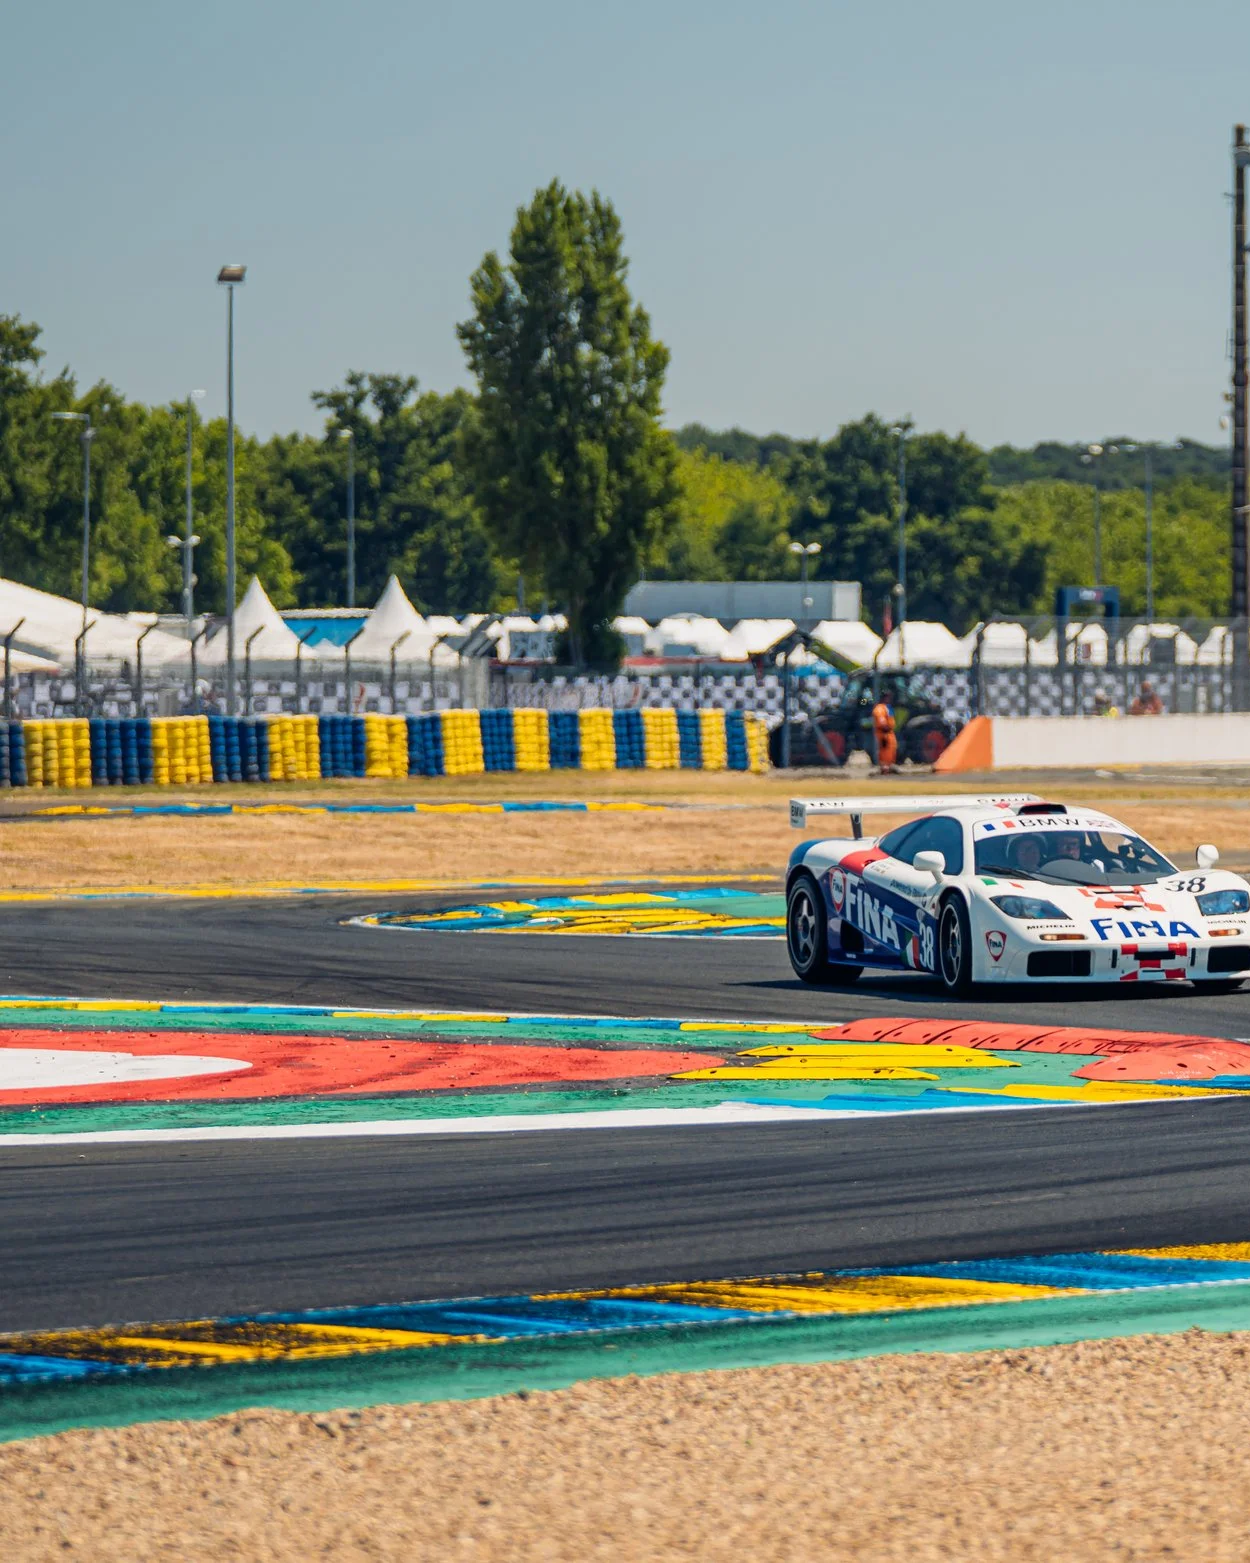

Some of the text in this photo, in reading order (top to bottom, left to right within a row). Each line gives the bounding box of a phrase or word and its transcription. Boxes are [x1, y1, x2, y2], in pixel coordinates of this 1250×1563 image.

[791, 804, 804, 818] BMW
[1018, 817, 1080, 828] BMW
[1165, 876, 1207, 893] 38
[845, 871, 901, 951] FINA
[1090, 917, 1202, 941] FINA
[919, 922, 936, 972] 38
[989, 938, 1003, 949] FINA
